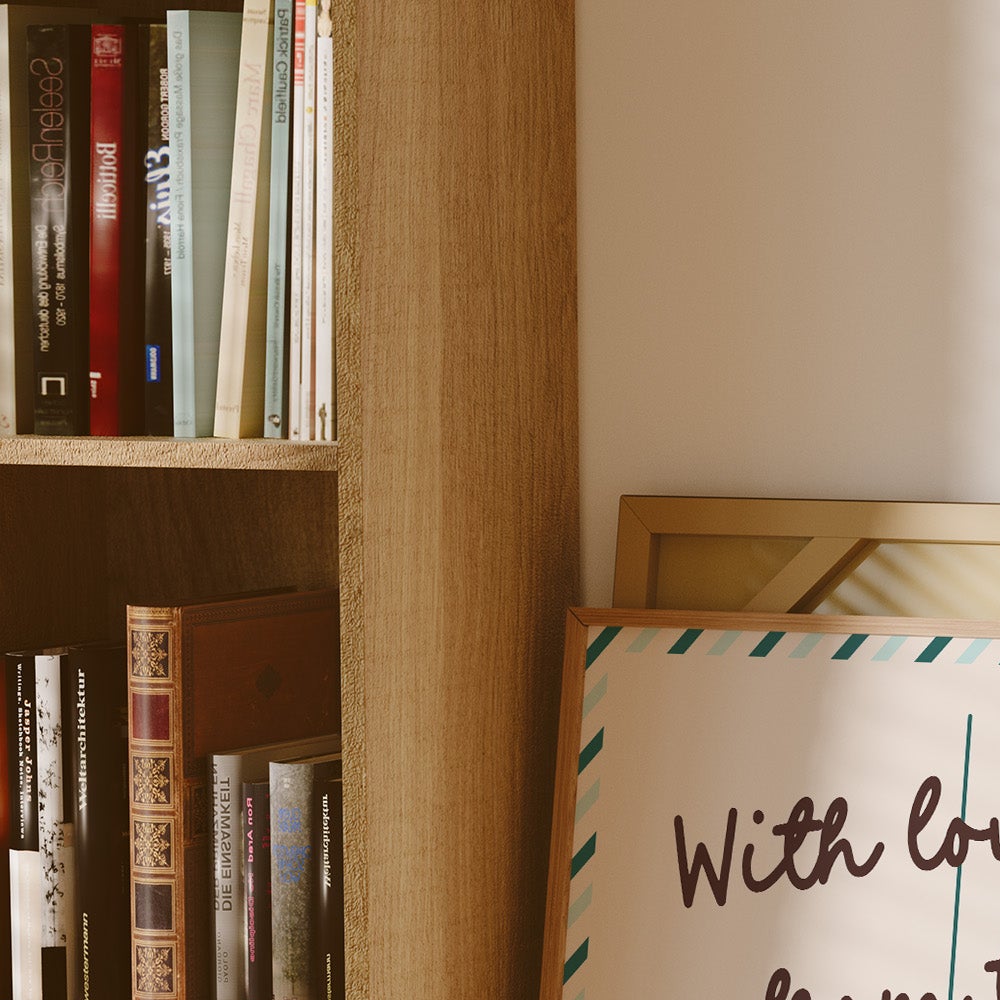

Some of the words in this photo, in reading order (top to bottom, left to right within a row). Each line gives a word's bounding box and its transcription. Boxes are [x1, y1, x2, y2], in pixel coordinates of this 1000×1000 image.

[23, 700, 32, 751] Jasper
[77, 668, 87, 811] Weltarchitektur
[25, 757, 33, 803] Johns
[674, 796, 885, 908] With
